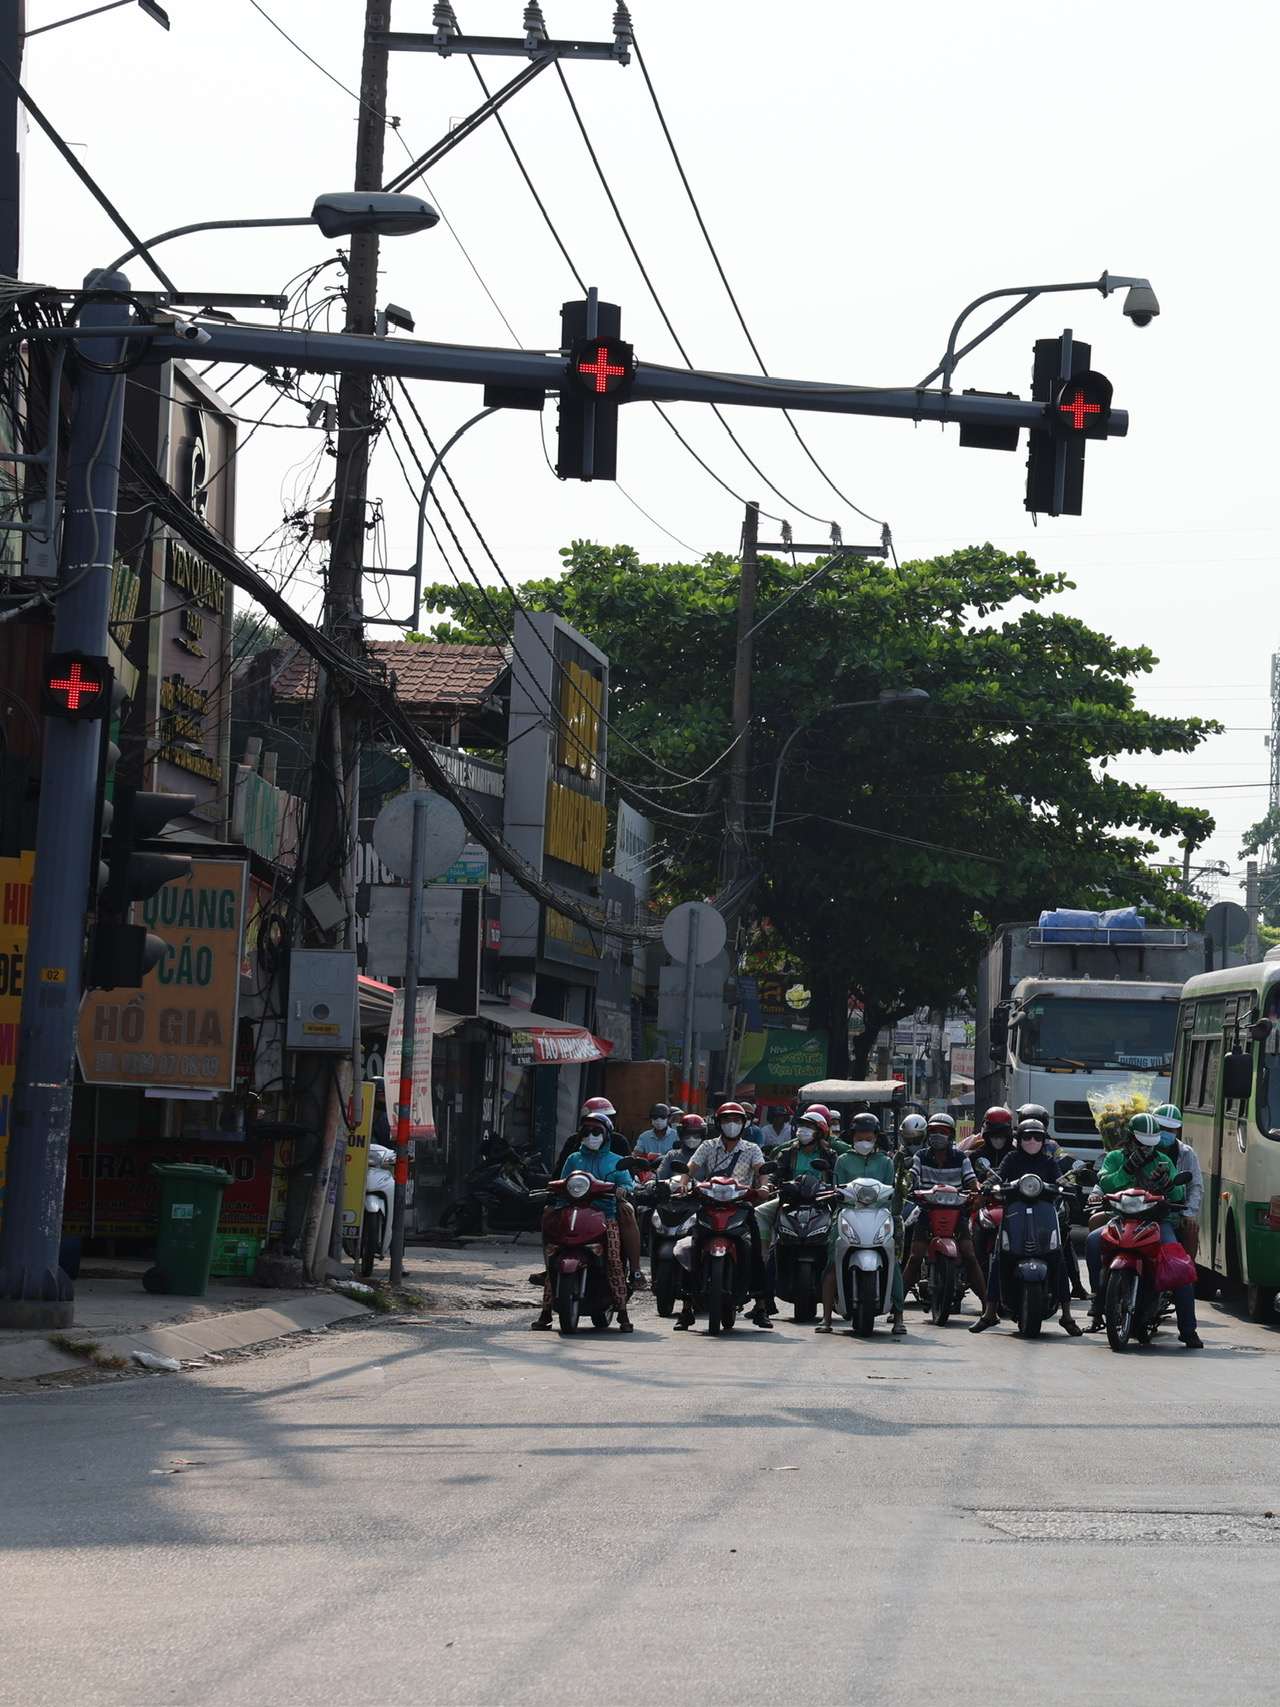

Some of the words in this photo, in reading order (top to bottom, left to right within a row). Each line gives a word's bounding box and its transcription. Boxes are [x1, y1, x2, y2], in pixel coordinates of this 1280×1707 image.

[142, 870, 236, 930] QUẢNG
[0, 945, 27, 997] ĐÈ
[46, 969, 59, 981] 02
[157, 935, 213, 986] CÁO
[93, 993, 146, 1043] HỒ
[159, 1007, 225, 1047] GIA
